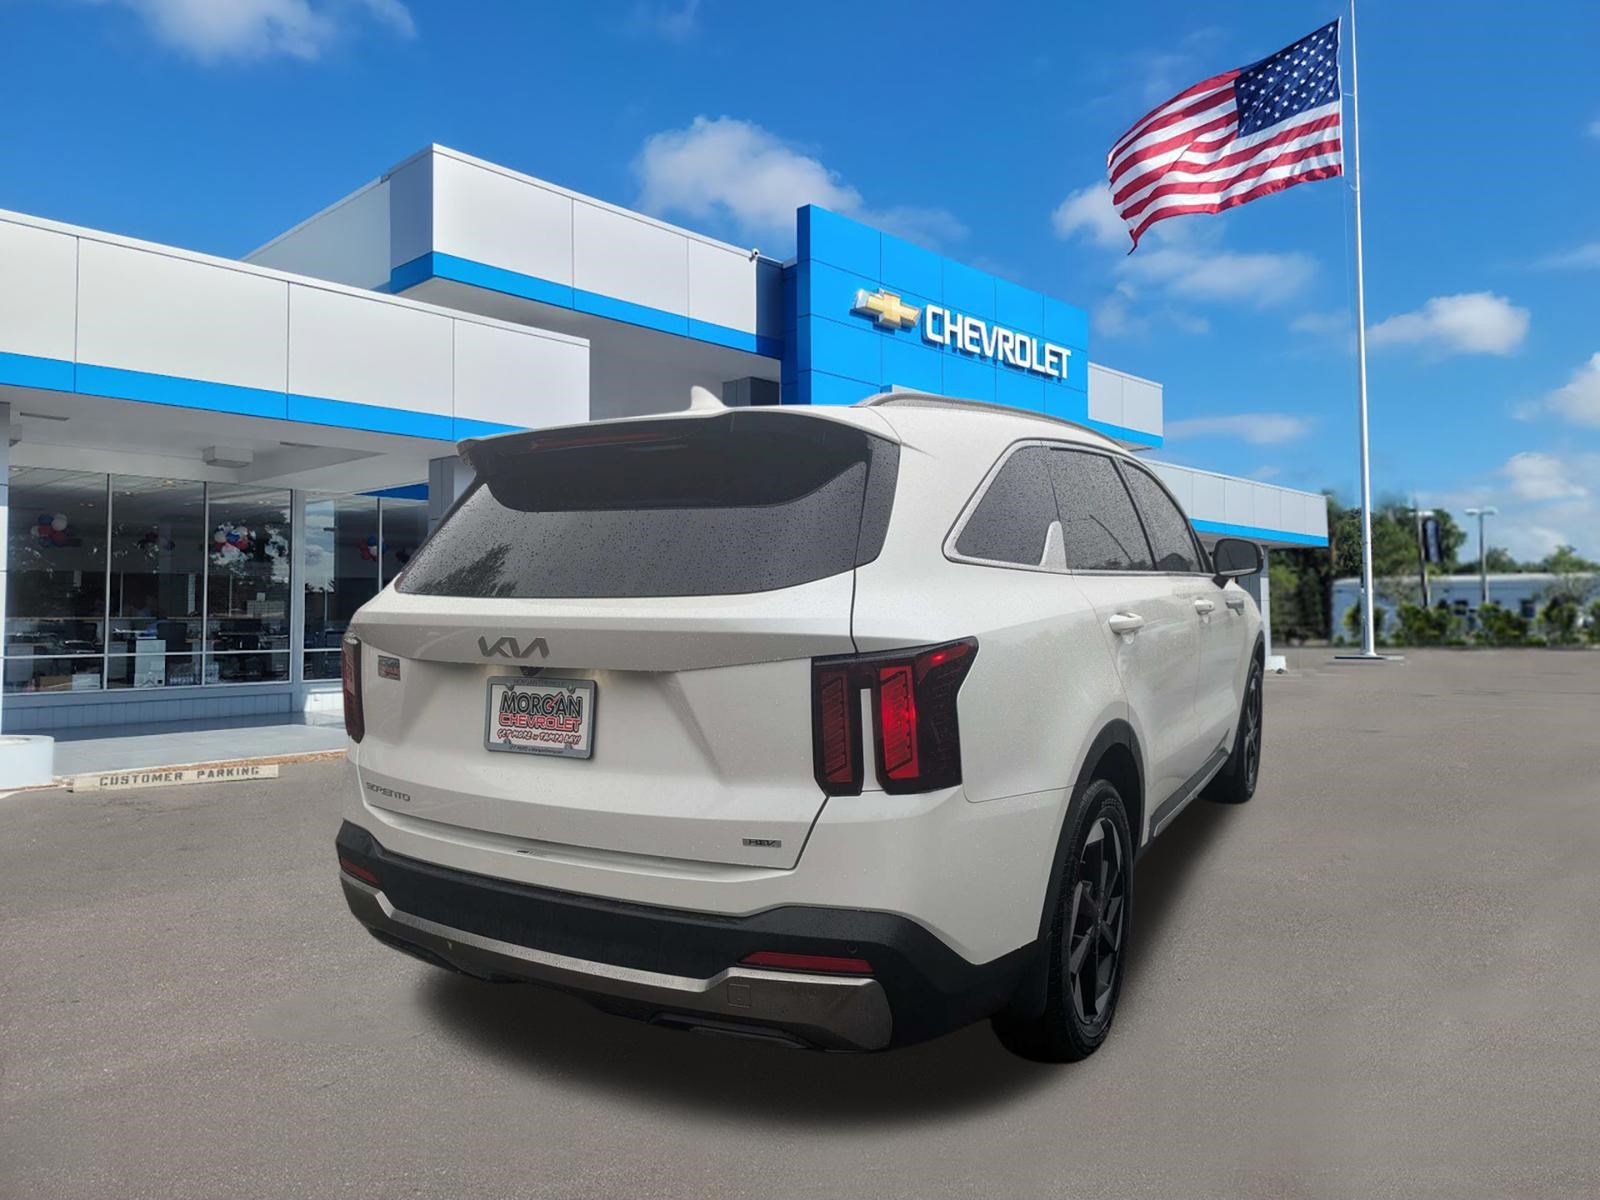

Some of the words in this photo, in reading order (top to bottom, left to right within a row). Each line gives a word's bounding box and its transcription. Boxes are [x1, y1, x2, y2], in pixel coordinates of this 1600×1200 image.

[924, 303, 1071, 379] CHEVROLET
[501, 690, 583, 717] MORGAN
[499, 713, 582, 732] CHEVROLET
[99, 771, 183, 787] CUSTOMER
[197, 766, 259, 779] PARKING
